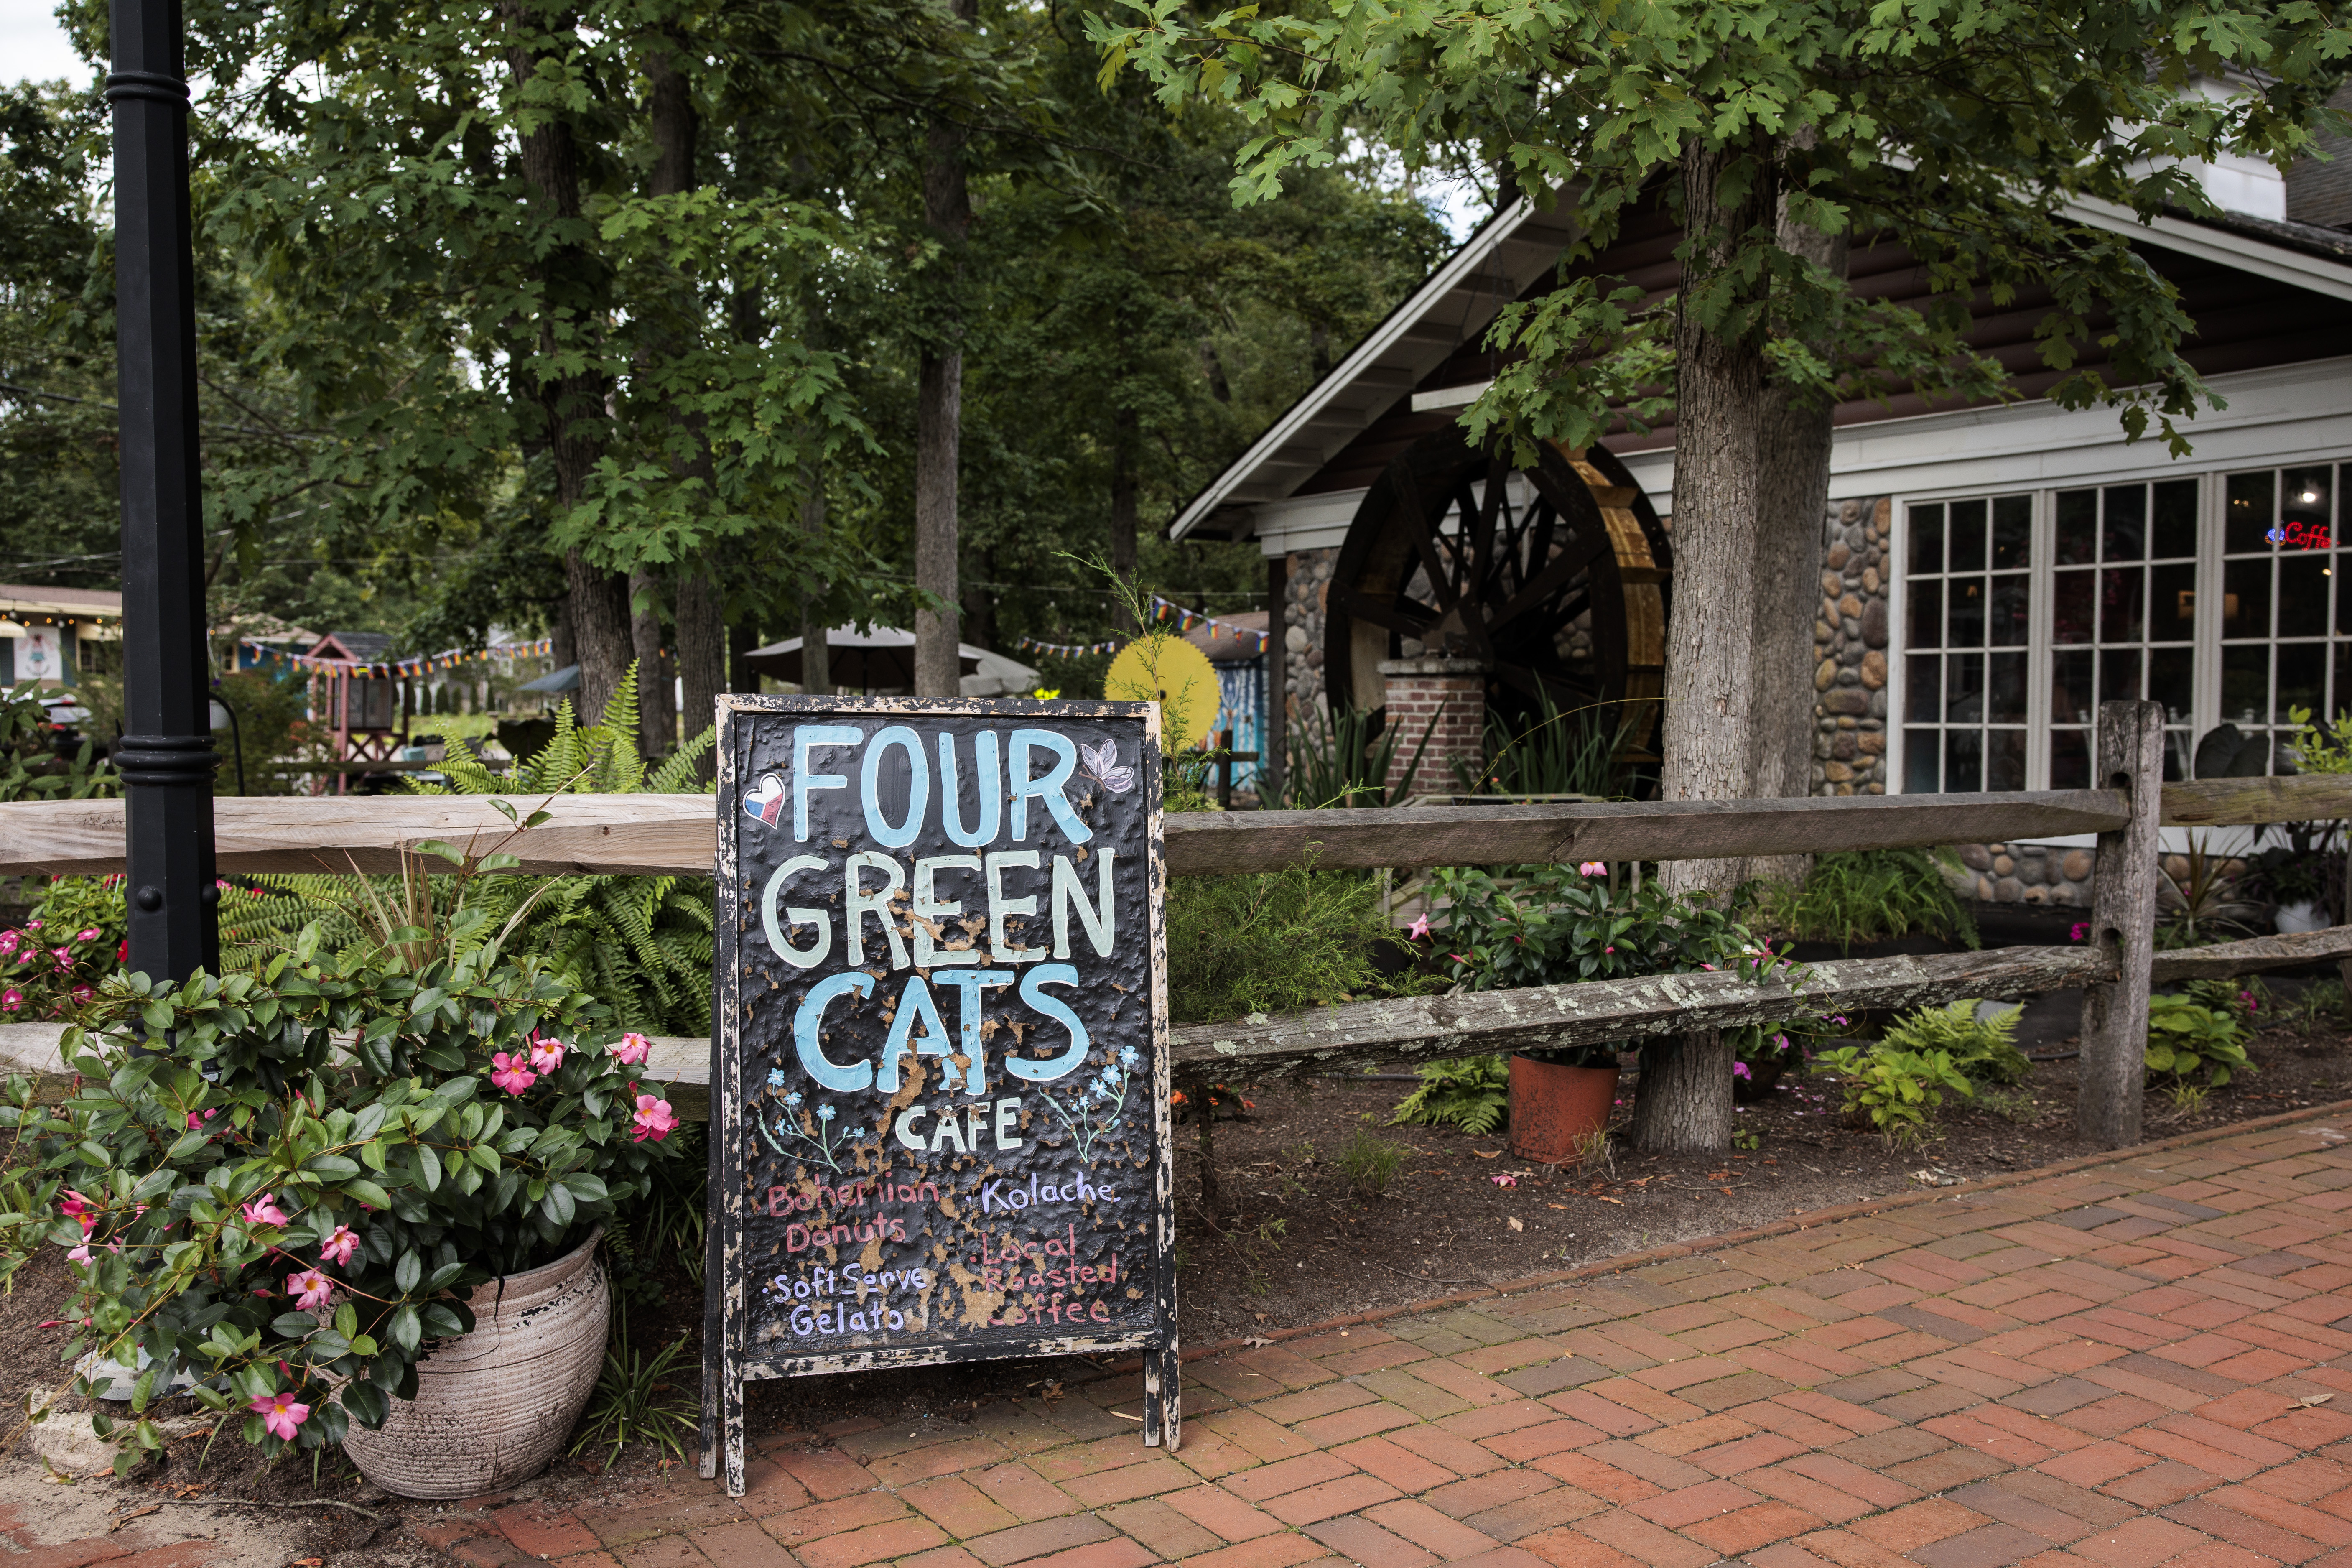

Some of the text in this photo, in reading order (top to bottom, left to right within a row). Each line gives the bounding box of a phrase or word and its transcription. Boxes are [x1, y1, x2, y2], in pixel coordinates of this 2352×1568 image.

[2285, 521, 2341, 551] Coffe
[793, 725, 1093, 848] FOUR
[761, 847, 1116, 970] GREEN
[793, 963, 1090, 1096] CATS
[895, 1096, 1022, 1152] CAFE
[768, 1171, 940, 1217] Bohemian
[982, 1171, 1121, 1214] Kolache
[787, 1211, 906, 1252] Donuts
[982, 1223, 1076, 1265] Local
[774, 1262, 927, 1303] Soft Serve
[790, 1301, 904, 1336] Gelato
